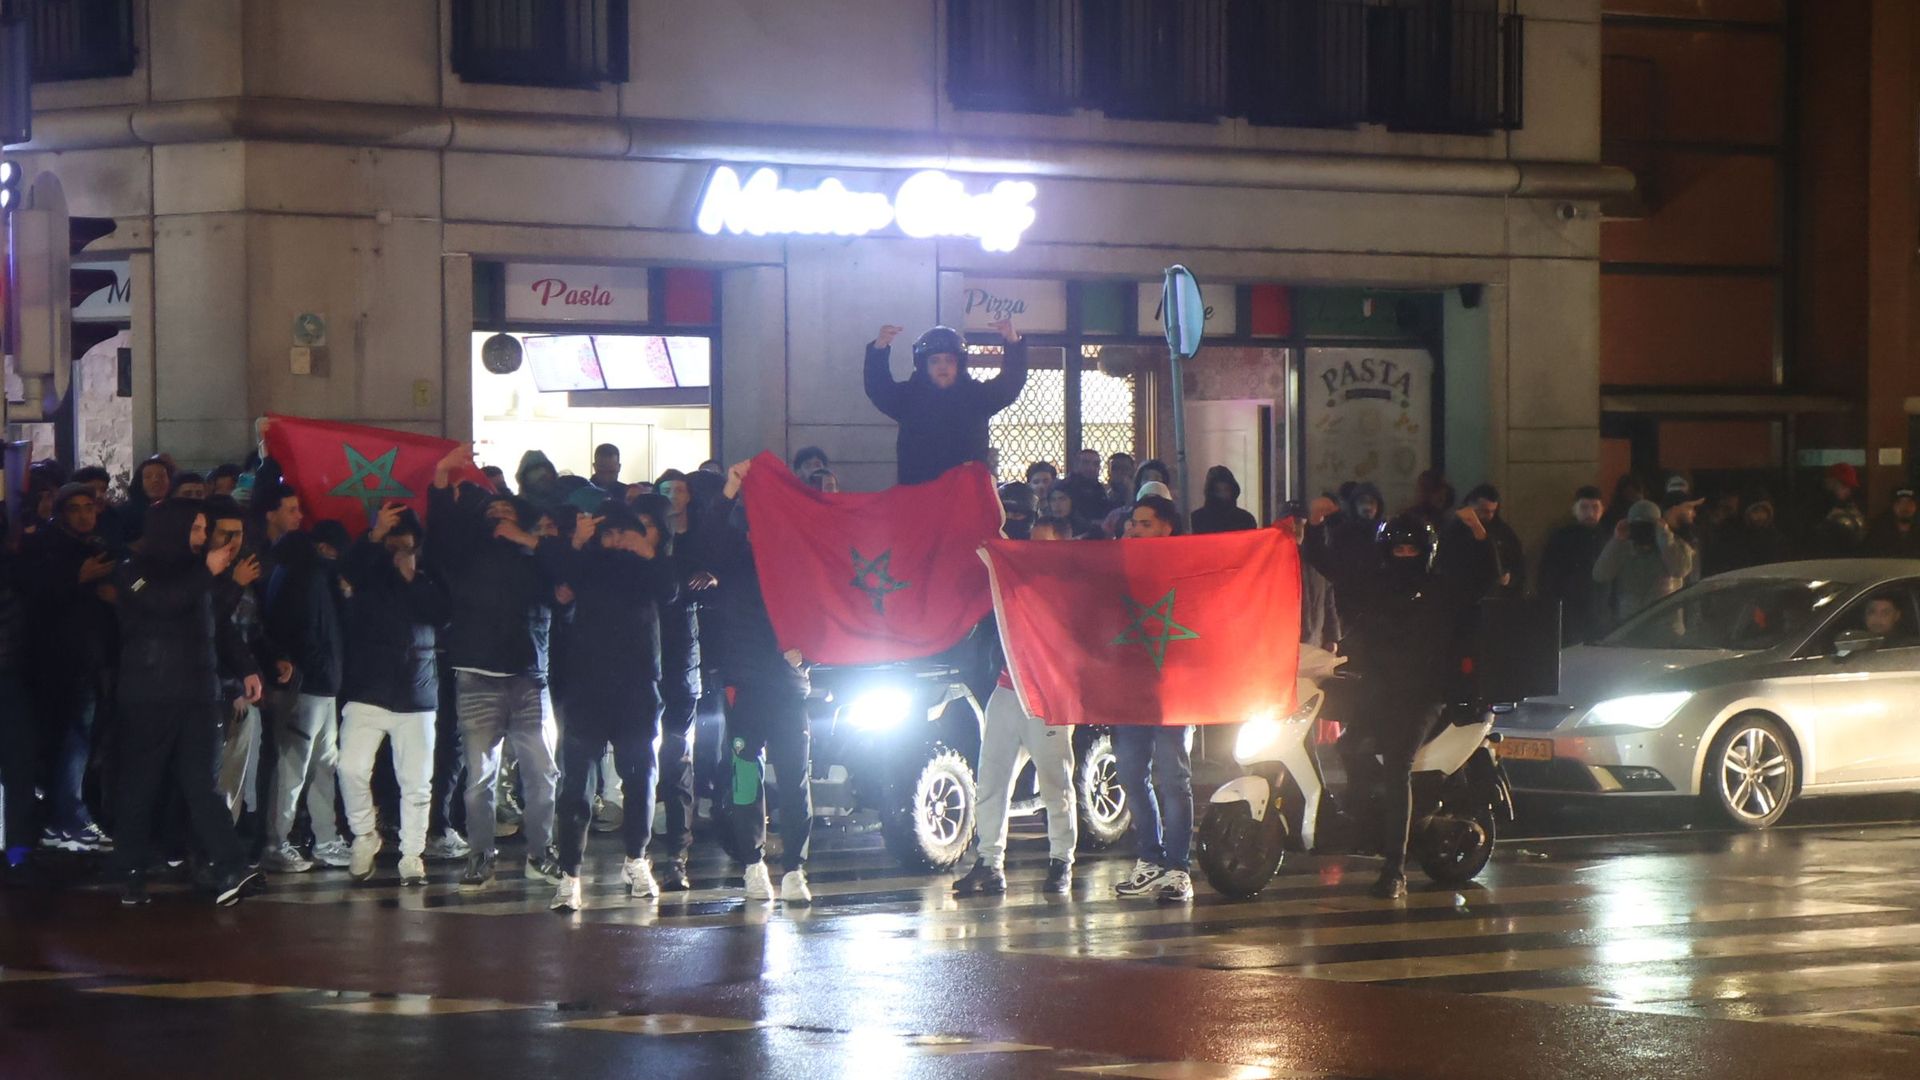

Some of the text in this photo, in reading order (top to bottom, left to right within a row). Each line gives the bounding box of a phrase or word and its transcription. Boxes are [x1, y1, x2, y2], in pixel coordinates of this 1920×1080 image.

[530, 277, 614, 306] Pasta
[963, 287, 1029, 321] Pizza
[1321, 358, 1411, 398] PASTA
